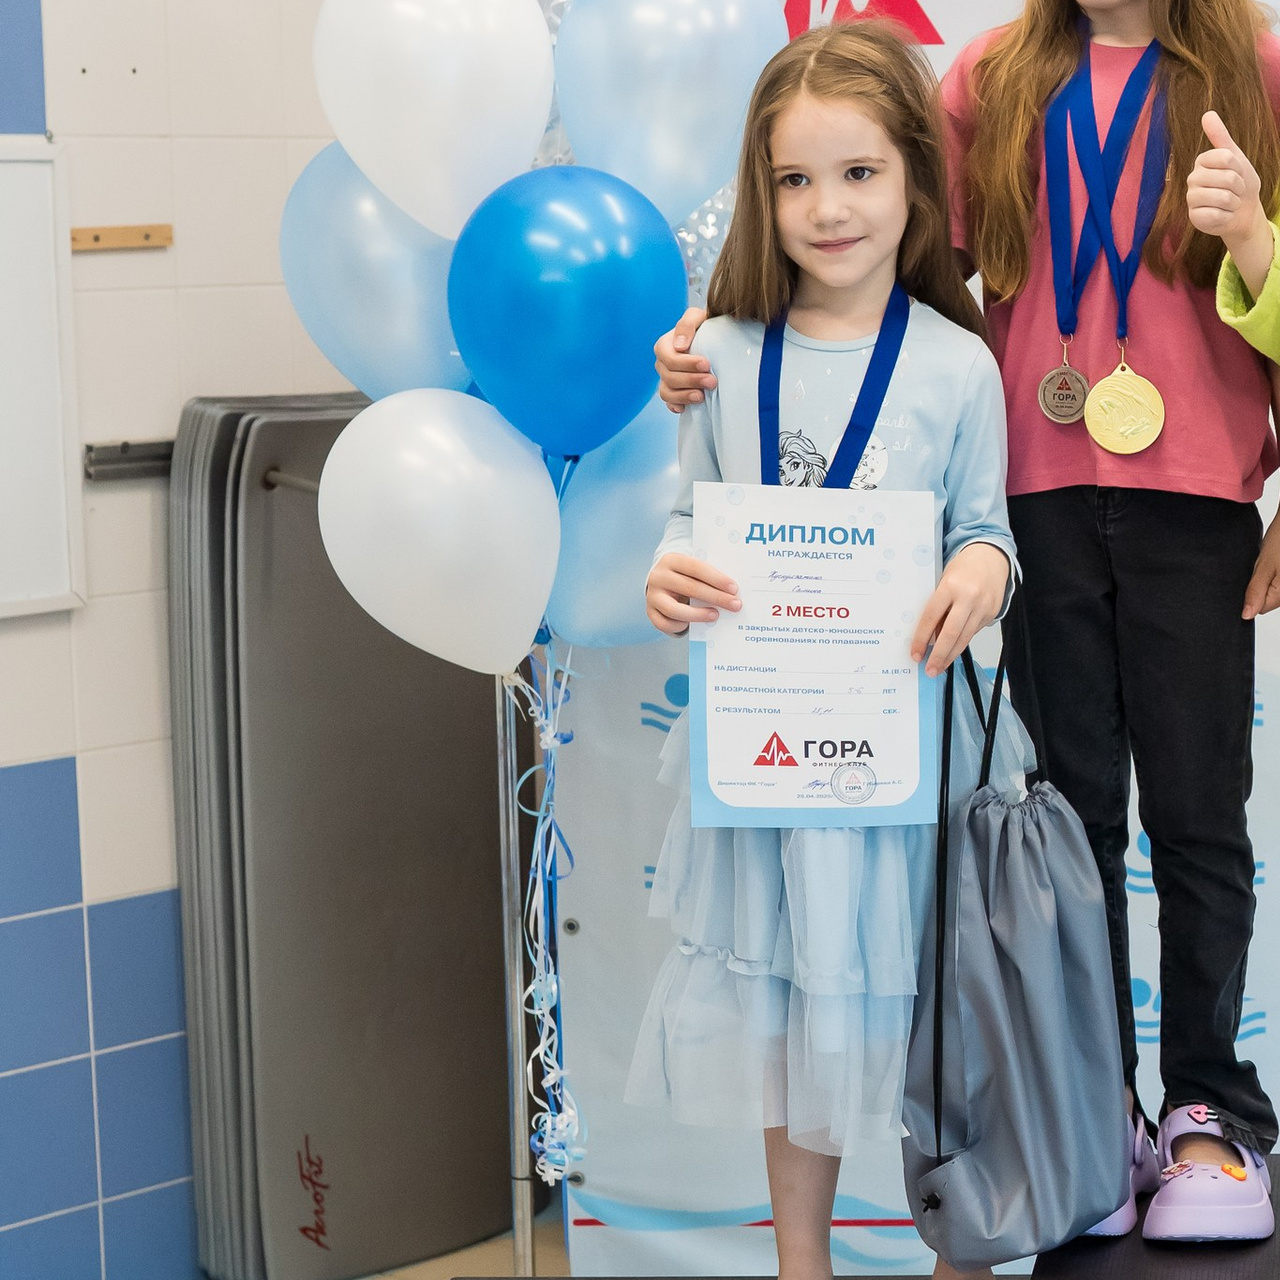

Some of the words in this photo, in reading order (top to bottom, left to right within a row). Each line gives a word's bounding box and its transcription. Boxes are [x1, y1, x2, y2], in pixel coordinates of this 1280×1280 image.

[1052, 393, 1077, 401] ГОРА
[745, 523, 875, 546] ДИПЛОМ
[767, 549, 853, 561] НАГРАЖДАЕТСЯ
[771, 604, 782, 617] 2
[786, 605, 850, 619] МЕСТО
[745, 624, 790, 634] закрытых
[791, 626, 885, 635] детско-юношеских
[745, 635, 817, 645] соревнованиях
[726, 665, 777, 673] ДИСТАНЦИИ
[721, 686, 776, 694] ВОЗРАСТНОЙ
[803, 740, 874, 759] ГОРА
